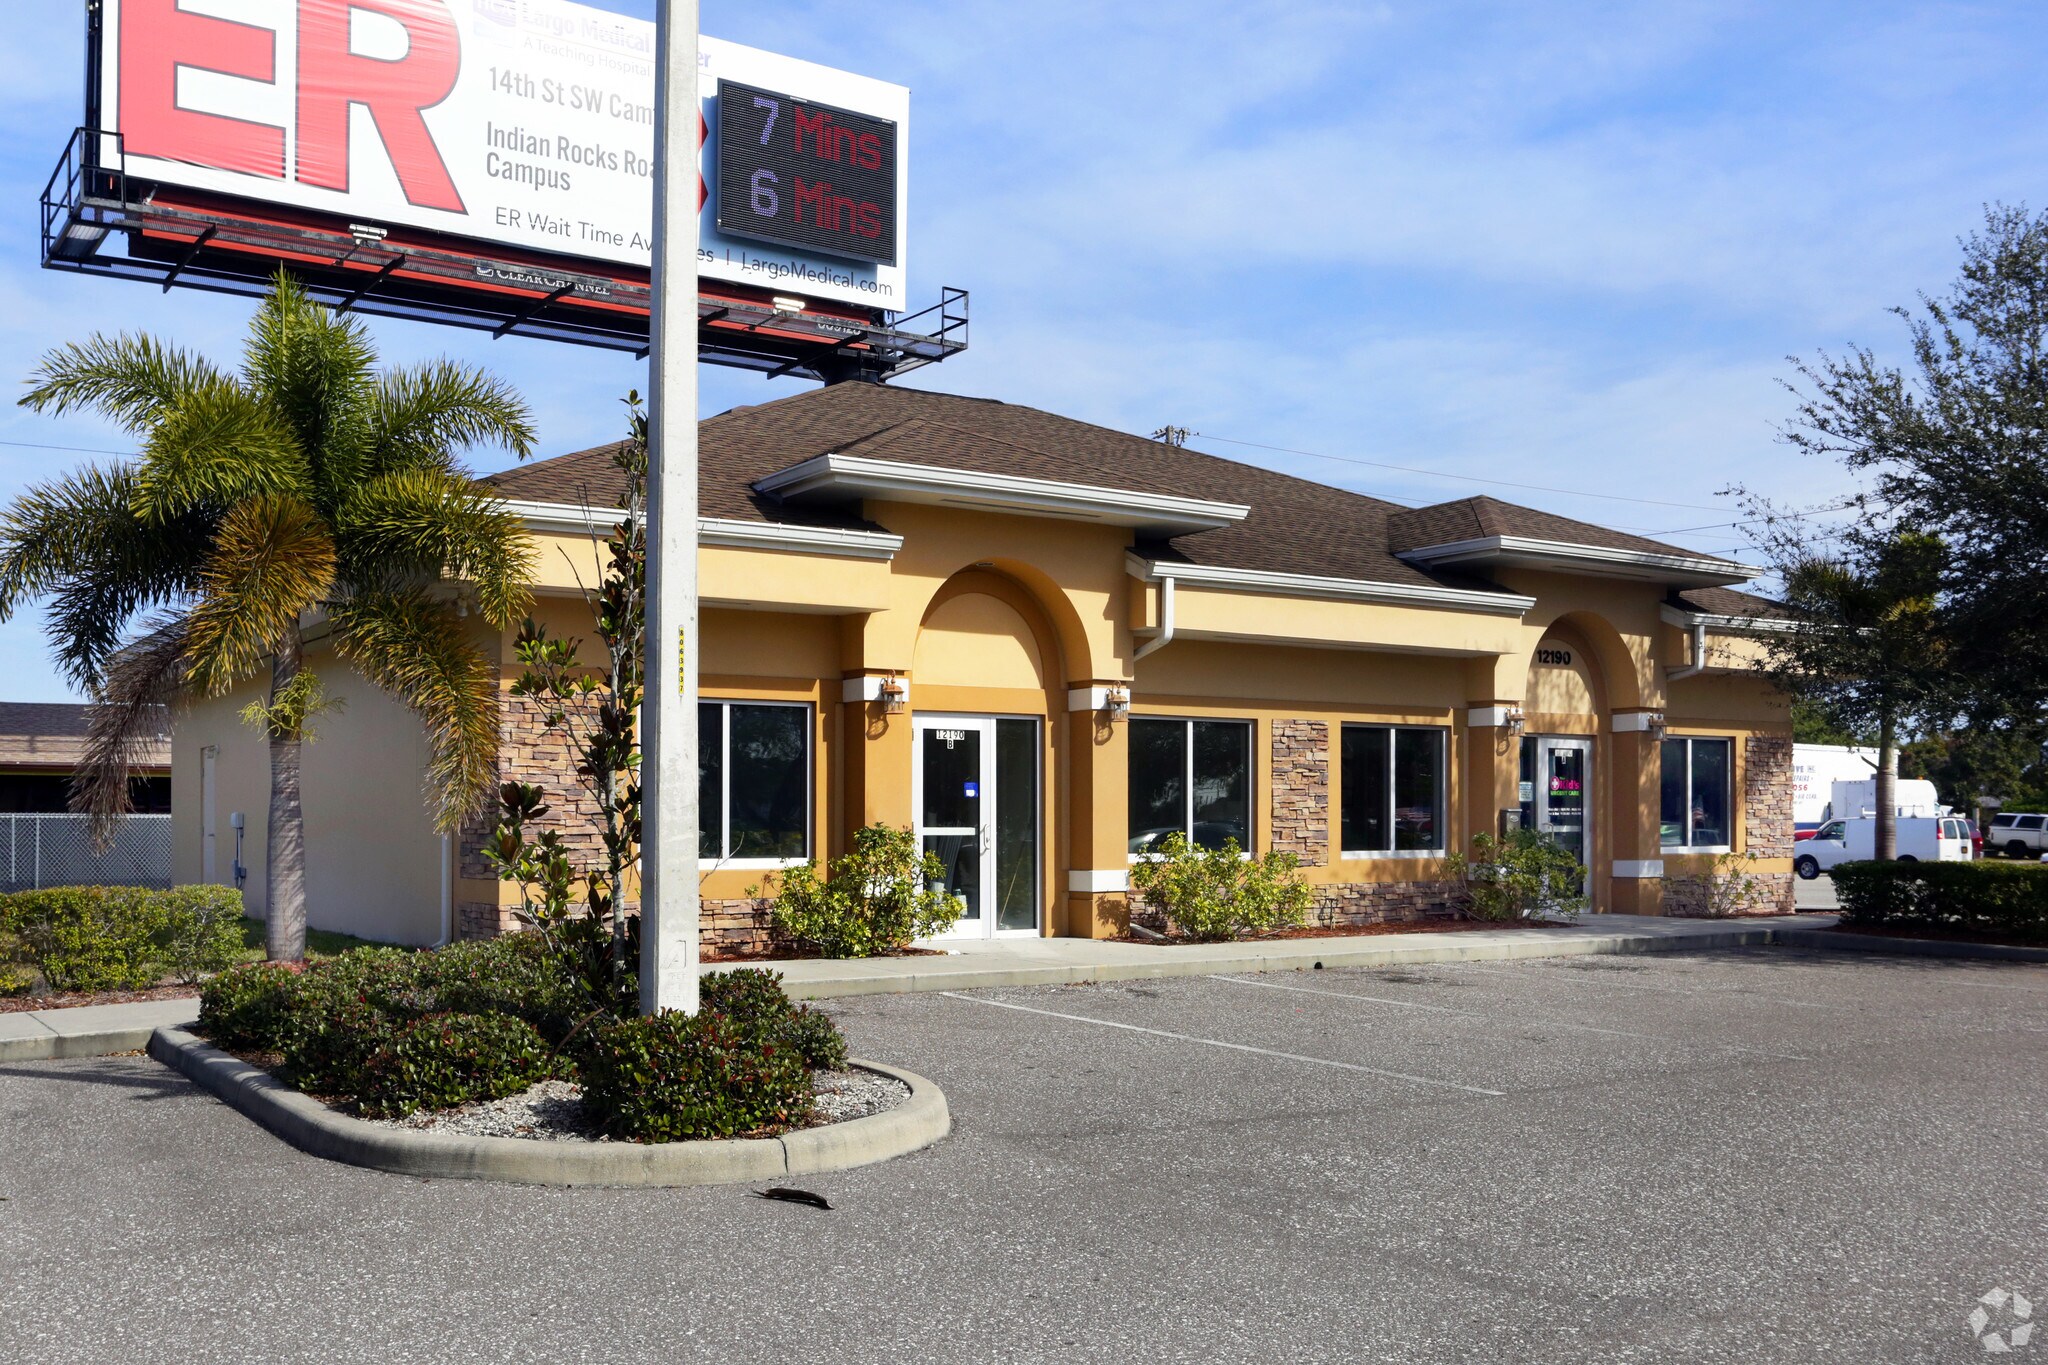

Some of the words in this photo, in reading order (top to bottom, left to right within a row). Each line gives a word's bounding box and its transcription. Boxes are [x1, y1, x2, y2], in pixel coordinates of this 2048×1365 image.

[522, 3, 575, 36] Largo
[581, 17, 650, 54] Medical
[524, 37, 533, 49] A
[536, 39, 595, 67] Teaching
[599, 54, 650, 77] Hospital
[117, 0, 469, 215] ER
[489, 66, 535, 99] 14th
[542, 78, 565, 106] St
[570, 84, 603, 114] SW
[487, 121, 550, 157] Indian
[557, 135, 618, 171] Rocks
[754, 96, 779, 145] 7
[794, 105, 881, 170] Mins
[487, 152, 571, 191] Campus
[751, 168, 779, 217] 6
[794, 176, 881, 239] Mins
[496, 206, 521, 228] ER
[528, 211, 571, 237] Wait
[578, 221, 623, 246] Time
[742, 251, 893, 296] LargoMedical.com
[1537, 650, 1571, 665] 12190
[937, 730, 964, 739] 12190
